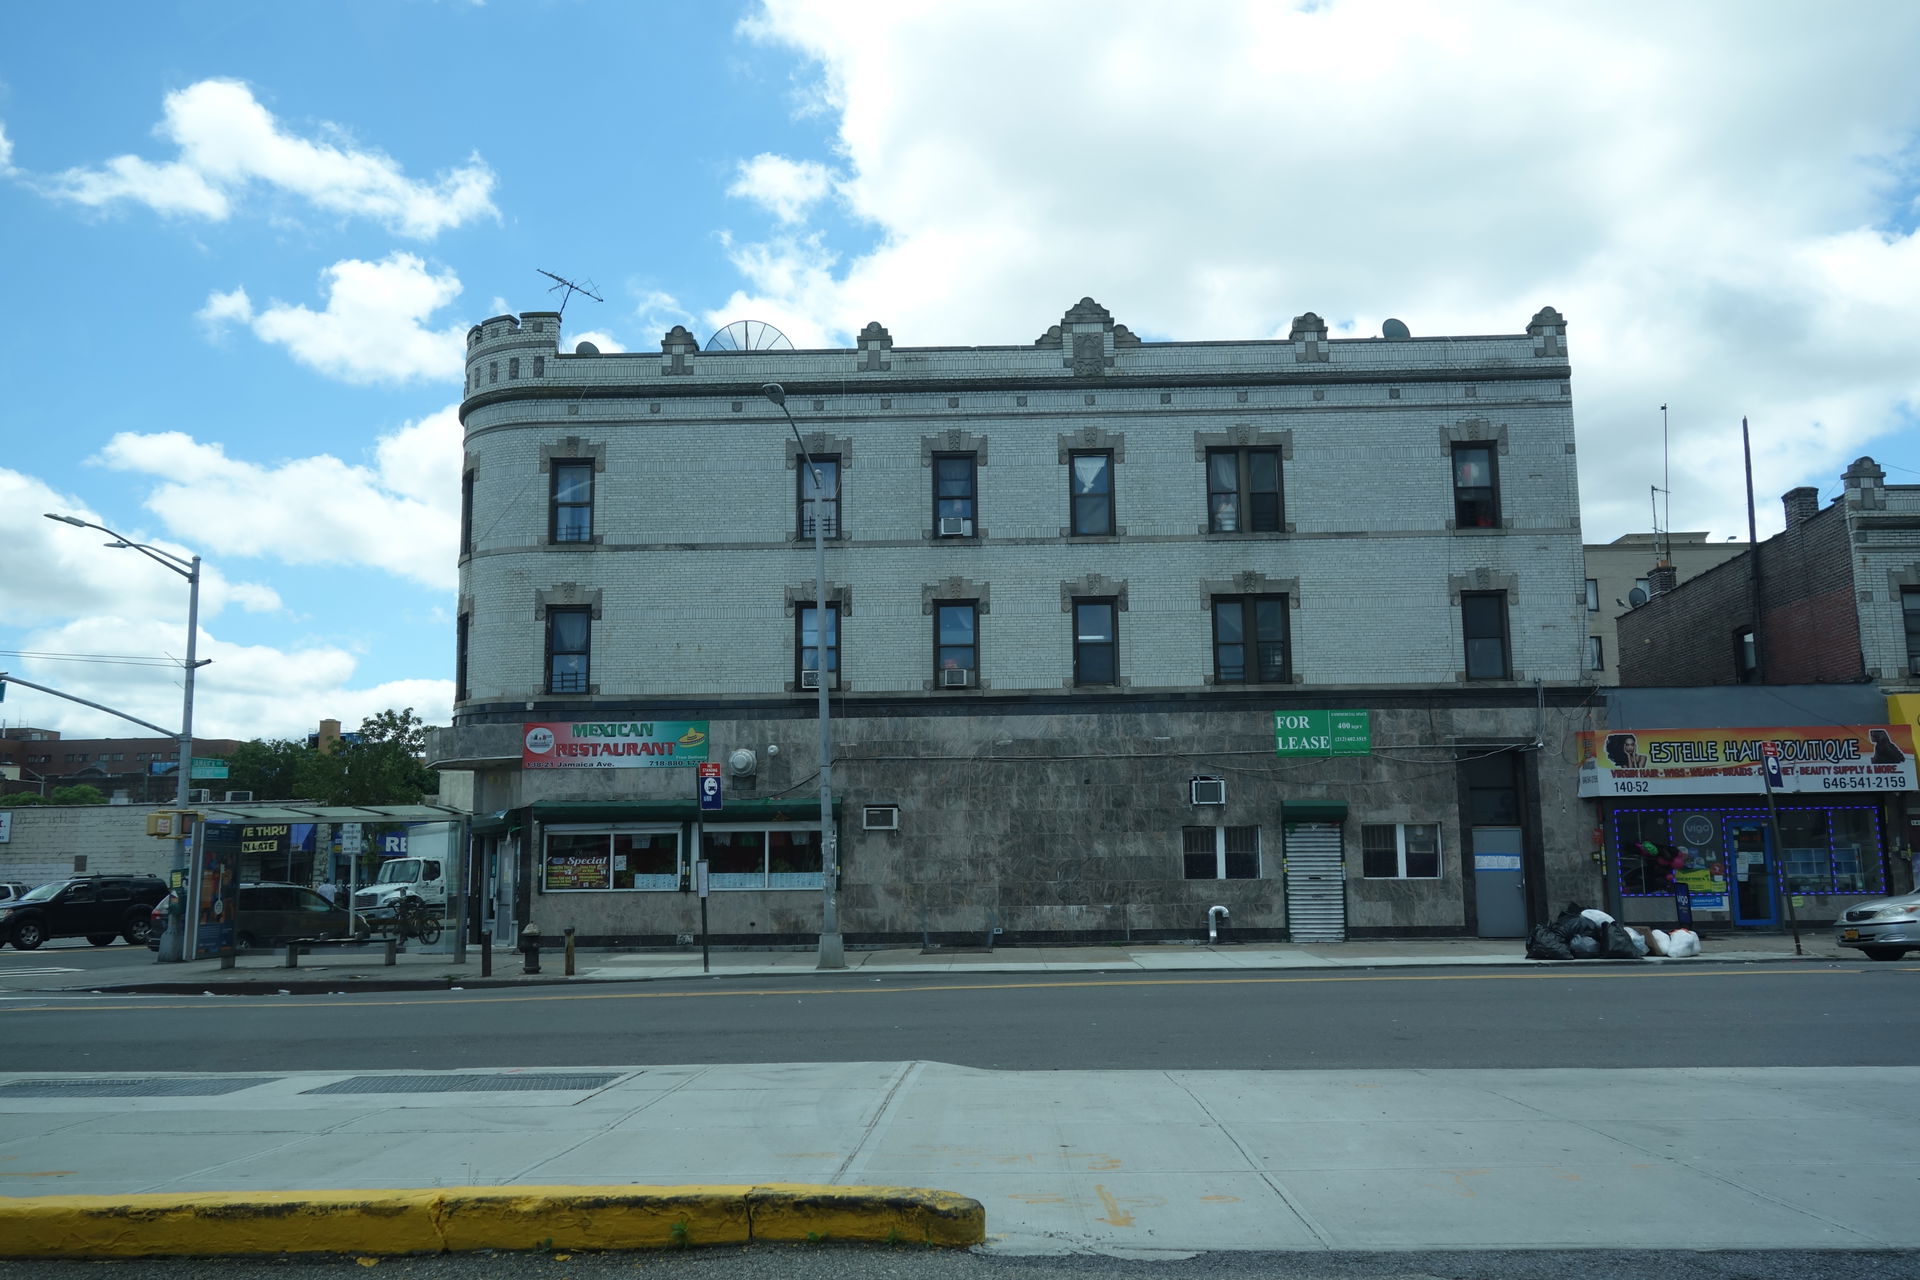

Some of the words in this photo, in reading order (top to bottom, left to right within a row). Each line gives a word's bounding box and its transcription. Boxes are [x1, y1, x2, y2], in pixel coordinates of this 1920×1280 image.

[1277, 716, 1310, 729] FOR
[572, 723, 653, 737] MEXICAN
[555, 742, 677, 757] RESTAURANT
[1278, 736, 1330, 750] LEASE
[1650, 741, 1719, 764] ESTELLE
[1611, 769, 1639, 778] VIRGIN
[1640, 769, 1659, 778] HAIR
[1664, 768, 1686, 778] WIGS
[1722, 767, 1753, 777] BRAIDS
[1800, 766, 1832, 775] BEAUTY
[1833, 765, 1865, 775] SUPPLY
[1866, 765, 1873, 774] &
[1614, 781, 1649, 793] 140-52
[1823, 776, 1906, 789] 646-541-2159
[256, 825, 287, 836] THRU
[252, 841, 276, 851] LATE
[567, 856, 607, 866] Special
